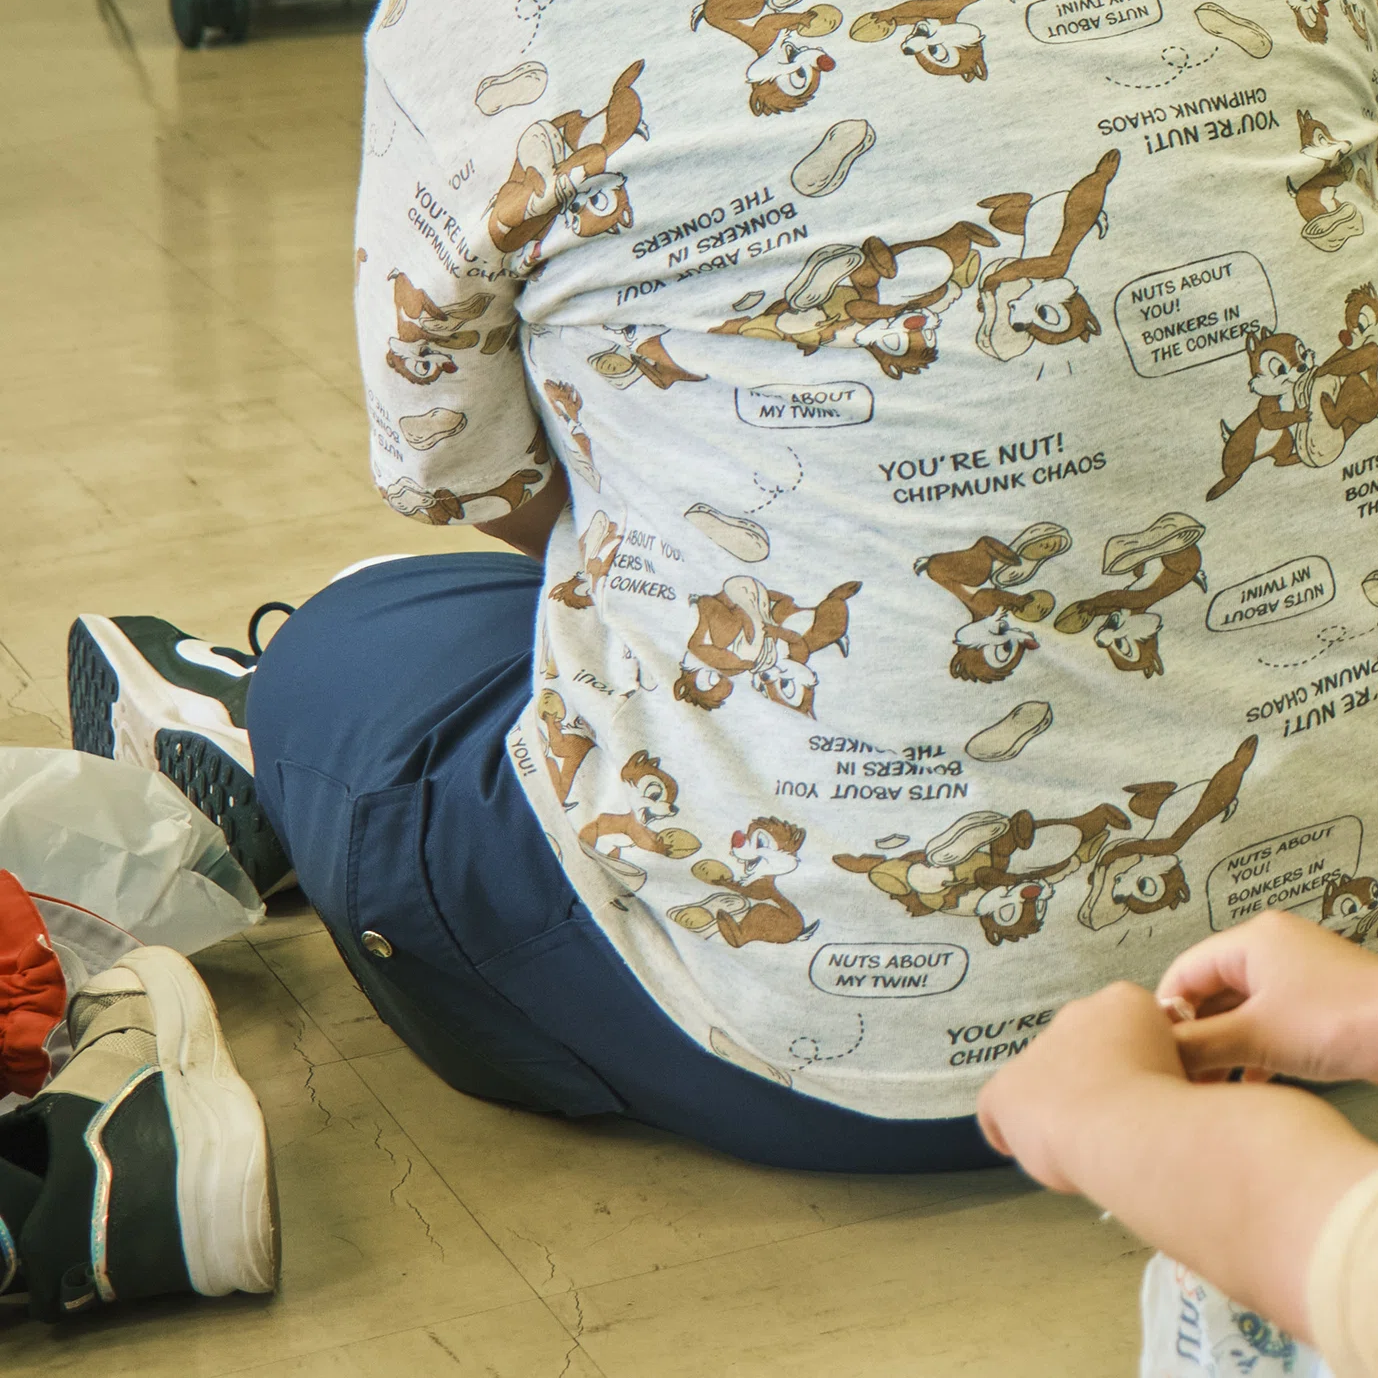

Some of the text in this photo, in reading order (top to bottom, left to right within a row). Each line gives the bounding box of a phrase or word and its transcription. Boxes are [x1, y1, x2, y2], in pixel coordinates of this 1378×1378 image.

[1047, 5, 1149, 38] NUTS ABOUT
[1097, 87, 1267, 136] CHIPMUNK CHAOS
[1144, 110, 1280, 155] YOU'RE NUT!
[414, 181, 461, 244] YOU'RE
[632, 187, 775, 260] THE CONKERS
[407, 207, 461, 279] CHIPMUNK
[668, 202, 798, 268] BONKERS IN
[748, 224, 809, 258] NUTS
[616, 279, 667, 307] YOU!
[1131, 263, 1232, 304] NUTS ABOUT
[1140, 298, 1180, 321] YOU!
[1142, 305, 1240, 345] BONKERS IN
[1151, 319, 1261, 363] THE CONKERS
[759, 405, 786, 418] MY
[879, 432, 1064, 482] YOU'RE NUT!
[893, 451, 1107, 504] CHIPMUNK CHAOS
[610, 575, 677, 601] CONKERS
[1241, 566, 1311, 603] MY TWIN!
[1220, 583, 1324, 625] NUTS ABOUT
[1246, 686, 1307, 723] CHAOS
[1283, 701, 1336, 737] NUT!
[511, 740, 537, 777] YOU!
[837, 761, 855, 775] IN
[902, 745, 946, 761] THE
[775, 780, 968, 801] NUTS ABOUT YOU!
[1227, 825, 1336, 871] NUTS ABOUT
[1228, 859, 1325, 906] BONKERS IN
[1232, 861, 1271, 884] YOU!
[1230, 868, 1341, 919] THE CONKERS
[828, 952, 953, 969] NUTS ABOUT
[835, 974, 928, 988] MY TWIN!
[947, 1009, 1053, 1045] YOU'RE
[950, 1035, 1032, 1066] CHIPM
